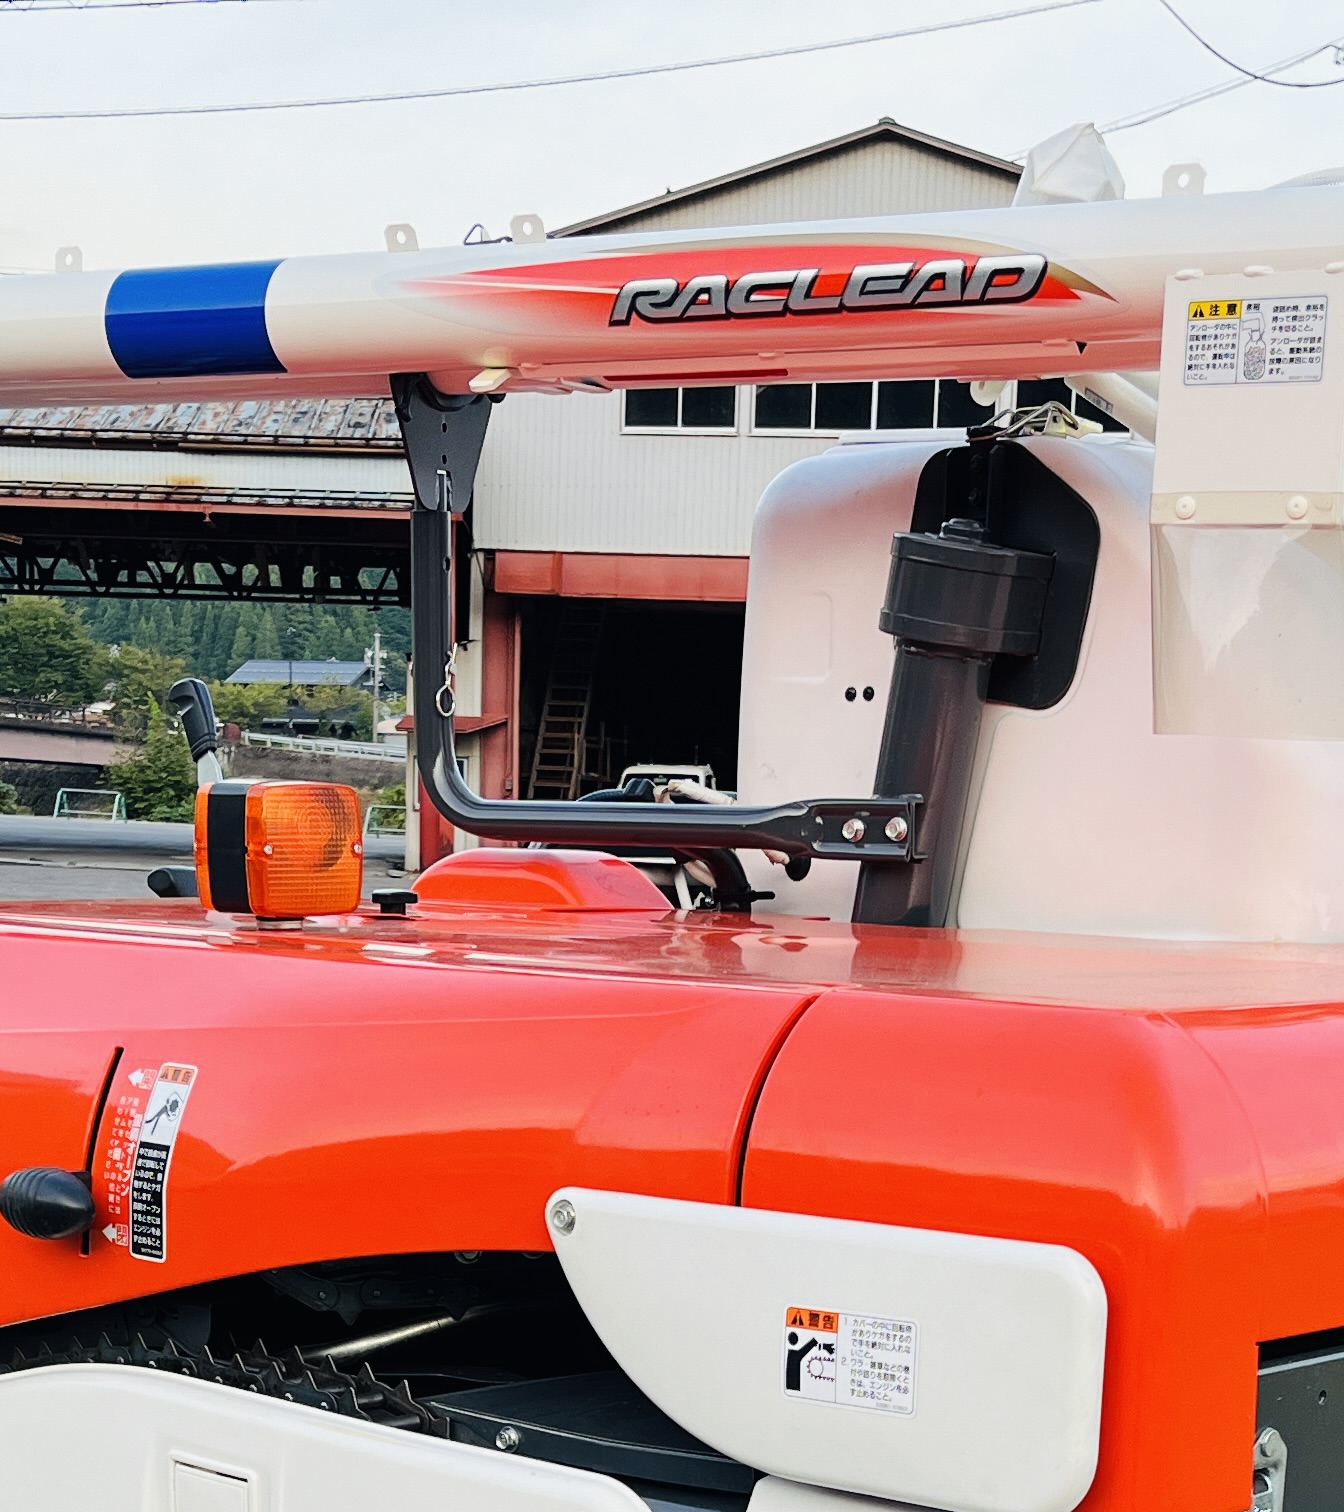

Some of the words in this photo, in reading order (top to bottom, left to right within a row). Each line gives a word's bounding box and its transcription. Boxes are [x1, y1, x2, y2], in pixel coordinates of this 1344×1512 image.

[609, 251, 1048, 326] RACLEAD
[1208, 302, 1237, 316] 注意
[1188, 342, 1236, 351] をするおそれがあ
[1187, 362, 1234, 371] 絶対に手を入れな
[1267, 367, 1284, 375] ます。
[808, 1312, 833, 1329] 警告
[850, 1348, 874, 1360] いこと。
